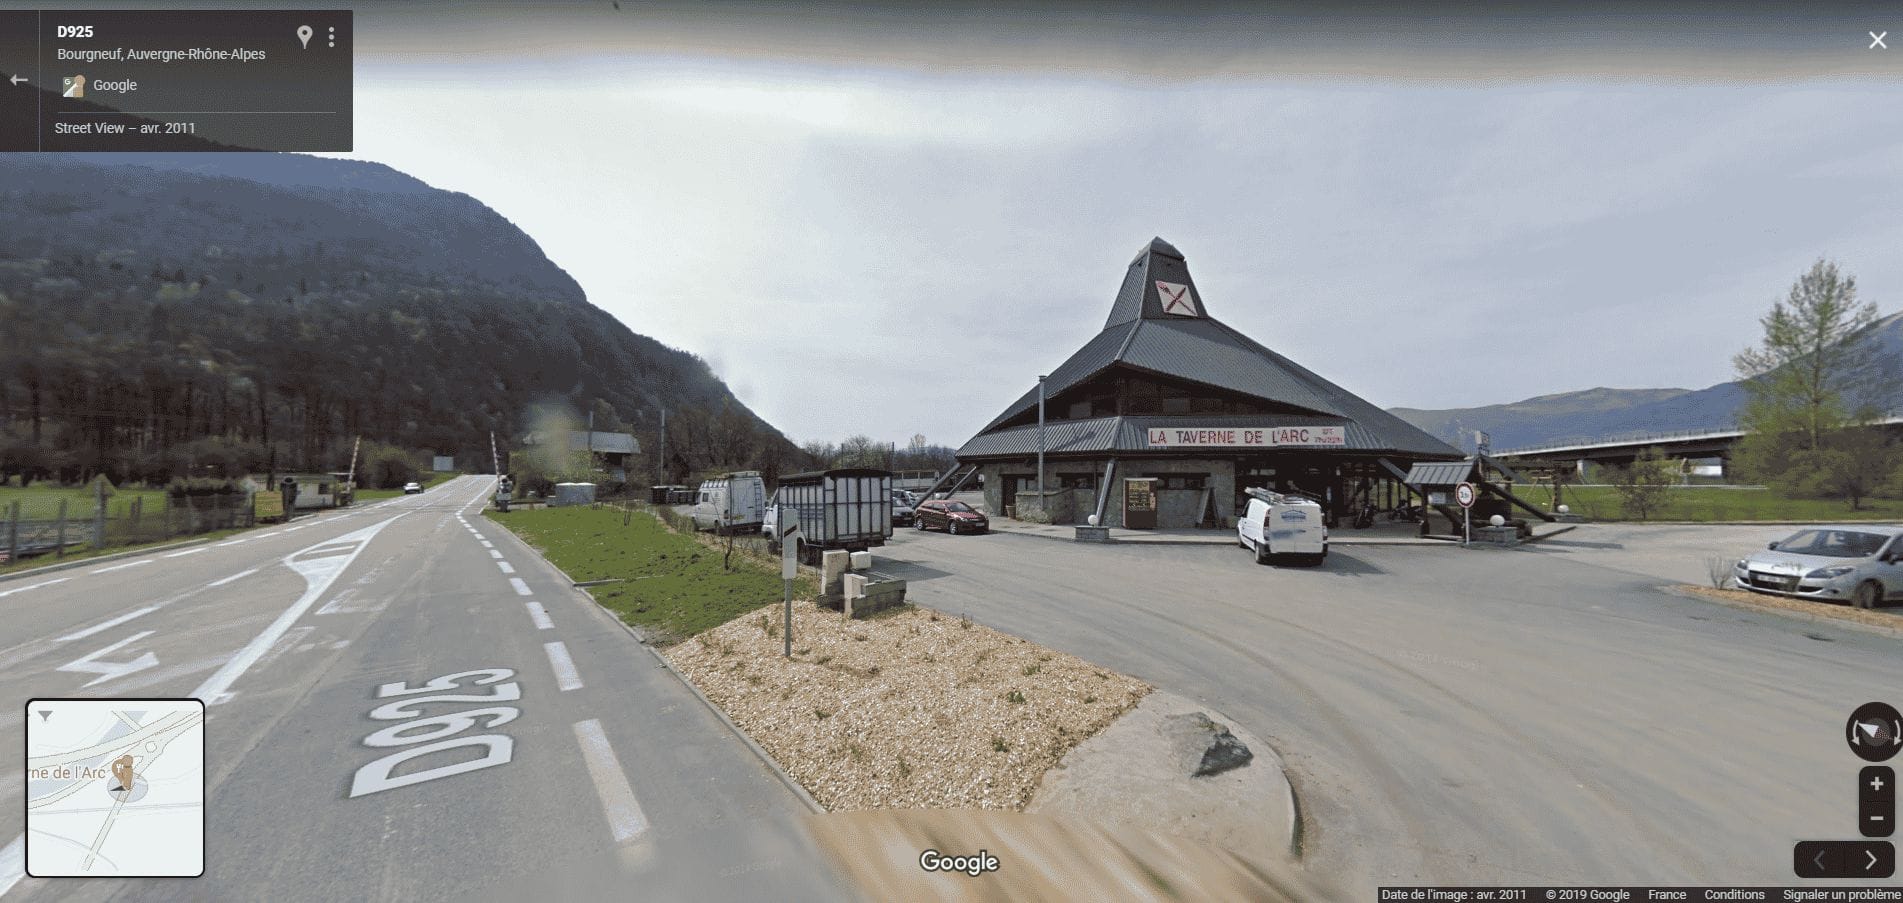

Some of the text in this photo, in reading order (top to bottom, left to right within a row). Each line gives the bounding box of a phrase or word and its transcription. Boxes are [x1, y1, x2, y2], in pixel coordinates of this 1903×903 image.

[1150, 431, 1167, 444] LA
[1176, 430, 1236, 444] TAVERNE
[1244, 430, 1263, 444] DE
[1273, 429, 1310, 443] L'ARC
